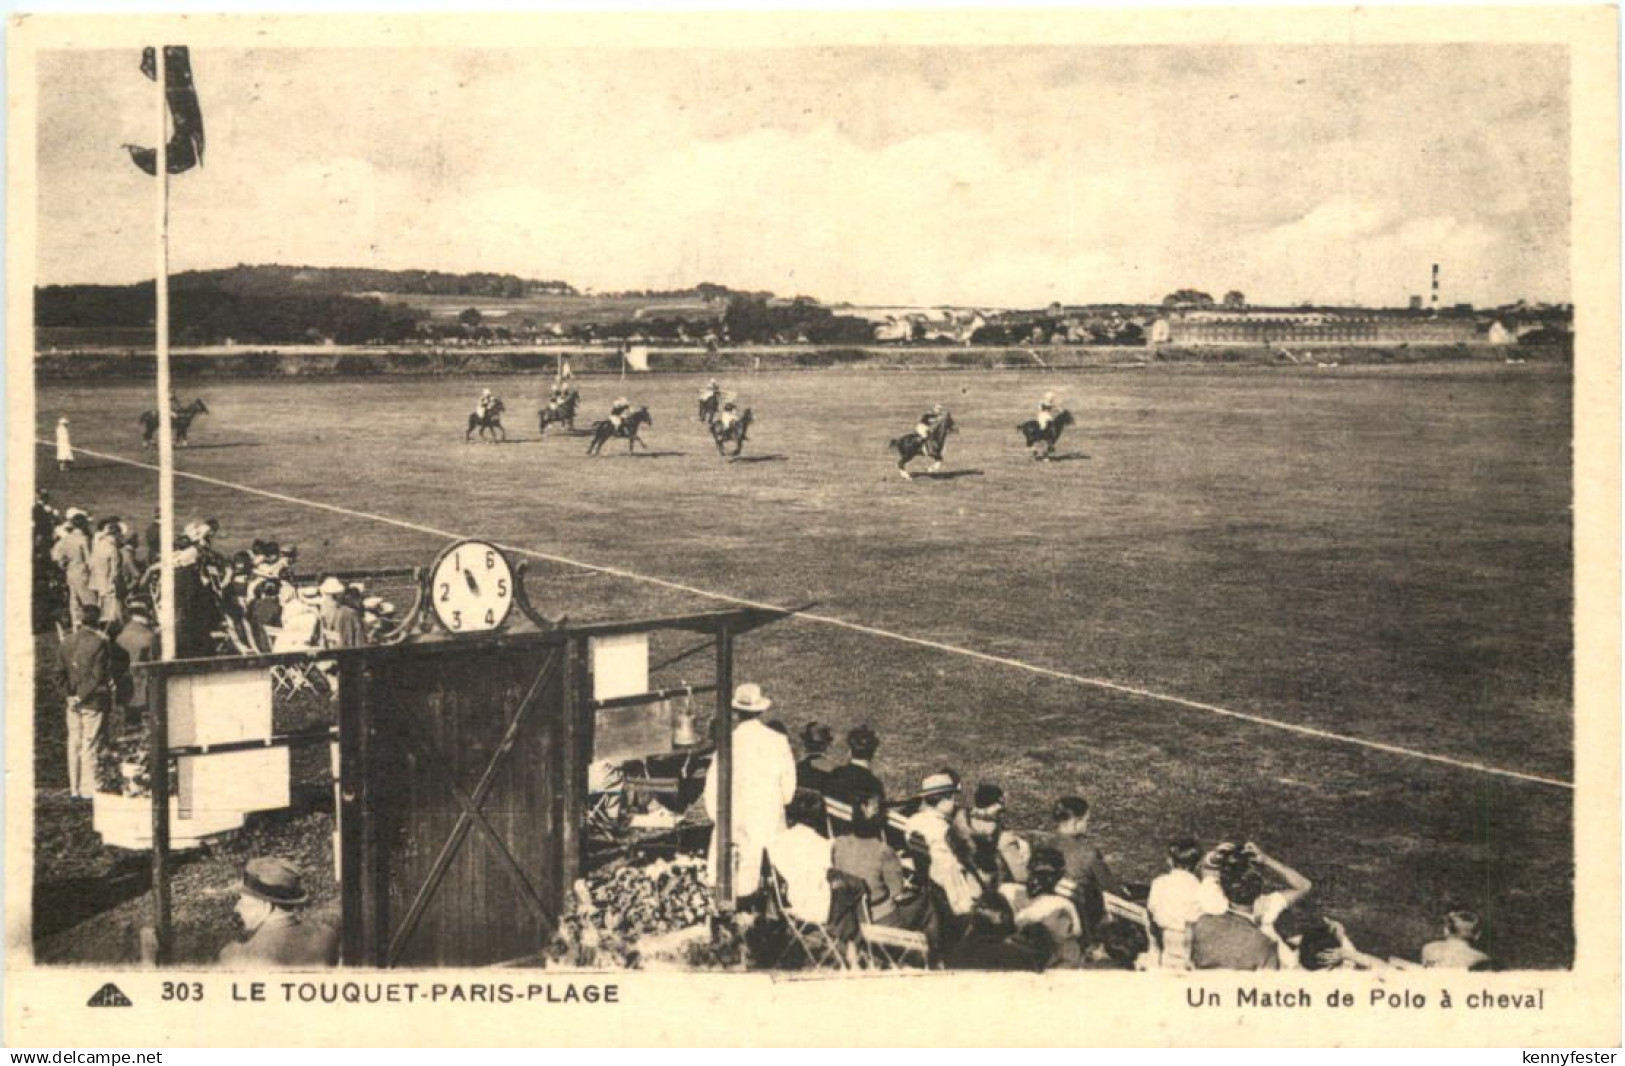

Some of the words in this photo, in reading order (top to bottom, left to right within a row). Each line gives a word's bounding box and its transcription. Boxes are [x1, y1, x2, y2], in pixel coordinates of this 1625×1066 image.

[486, 551, 495, 569] 6
[440, 583, 450, 601] 2
[497, 579, 507, 597] 5
[452, 611, 462, 629] 3
[485, 608, 494, 625] 4
